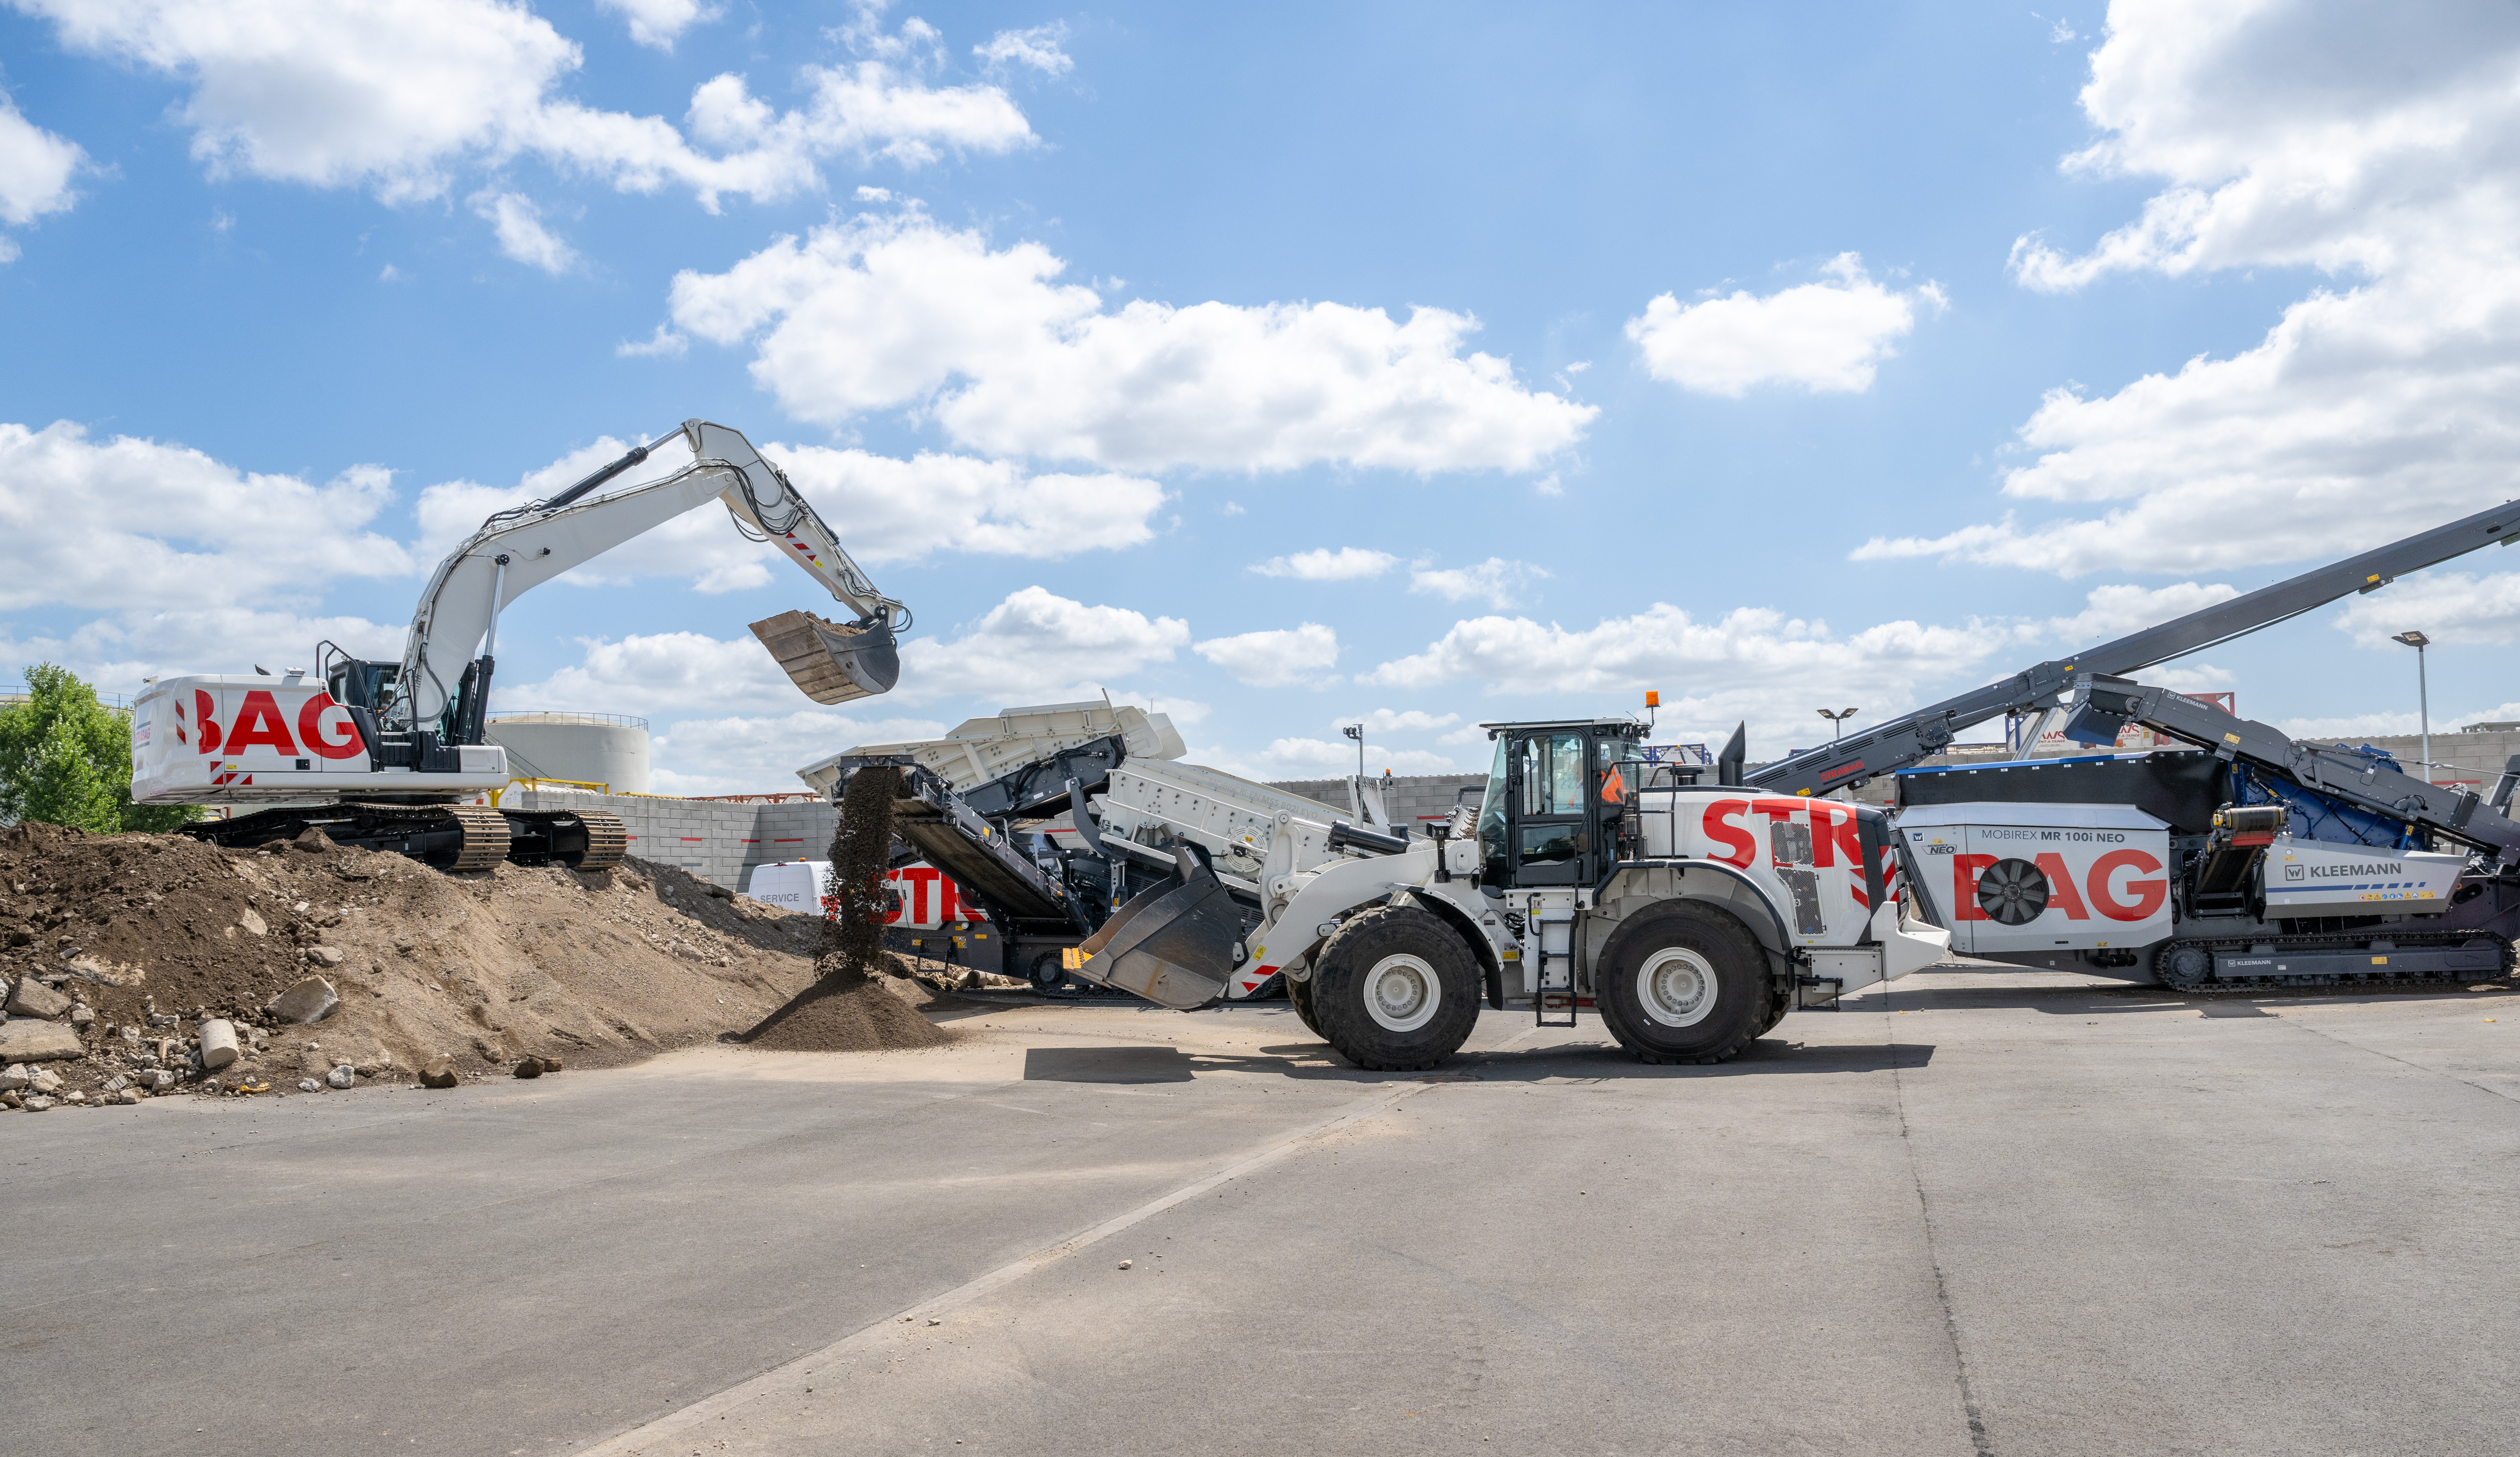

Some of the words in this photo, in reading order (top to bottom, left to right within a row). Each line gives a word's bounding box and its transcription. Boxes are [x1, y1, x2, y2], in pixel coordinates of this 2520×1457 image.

[2176, 695, 2208, 710] KLEEMANN
[195, 689, 366, 759] BAG
[135, 728, 150, 744] STRABAG
[1820, 760, 1864, 781] STRABAG
[1209, 778, 1260, 800] MOBISCREEN
[1261, 795, 1279, 806] MSS
[1281, 801, 1299, 813] 802i
[1301, 808, 1318, 819] EVO
[1982, 830, 2038, 840] MOBIREX
[2041, 831, 2061, 840] MR
[2065, 832, 2092, 842] 100i
[2097, 833, 2125, 843] NEO
[2310, 863, 2401, 877] KLEEMANN
[760, 893, 799, 903] SERVICE
